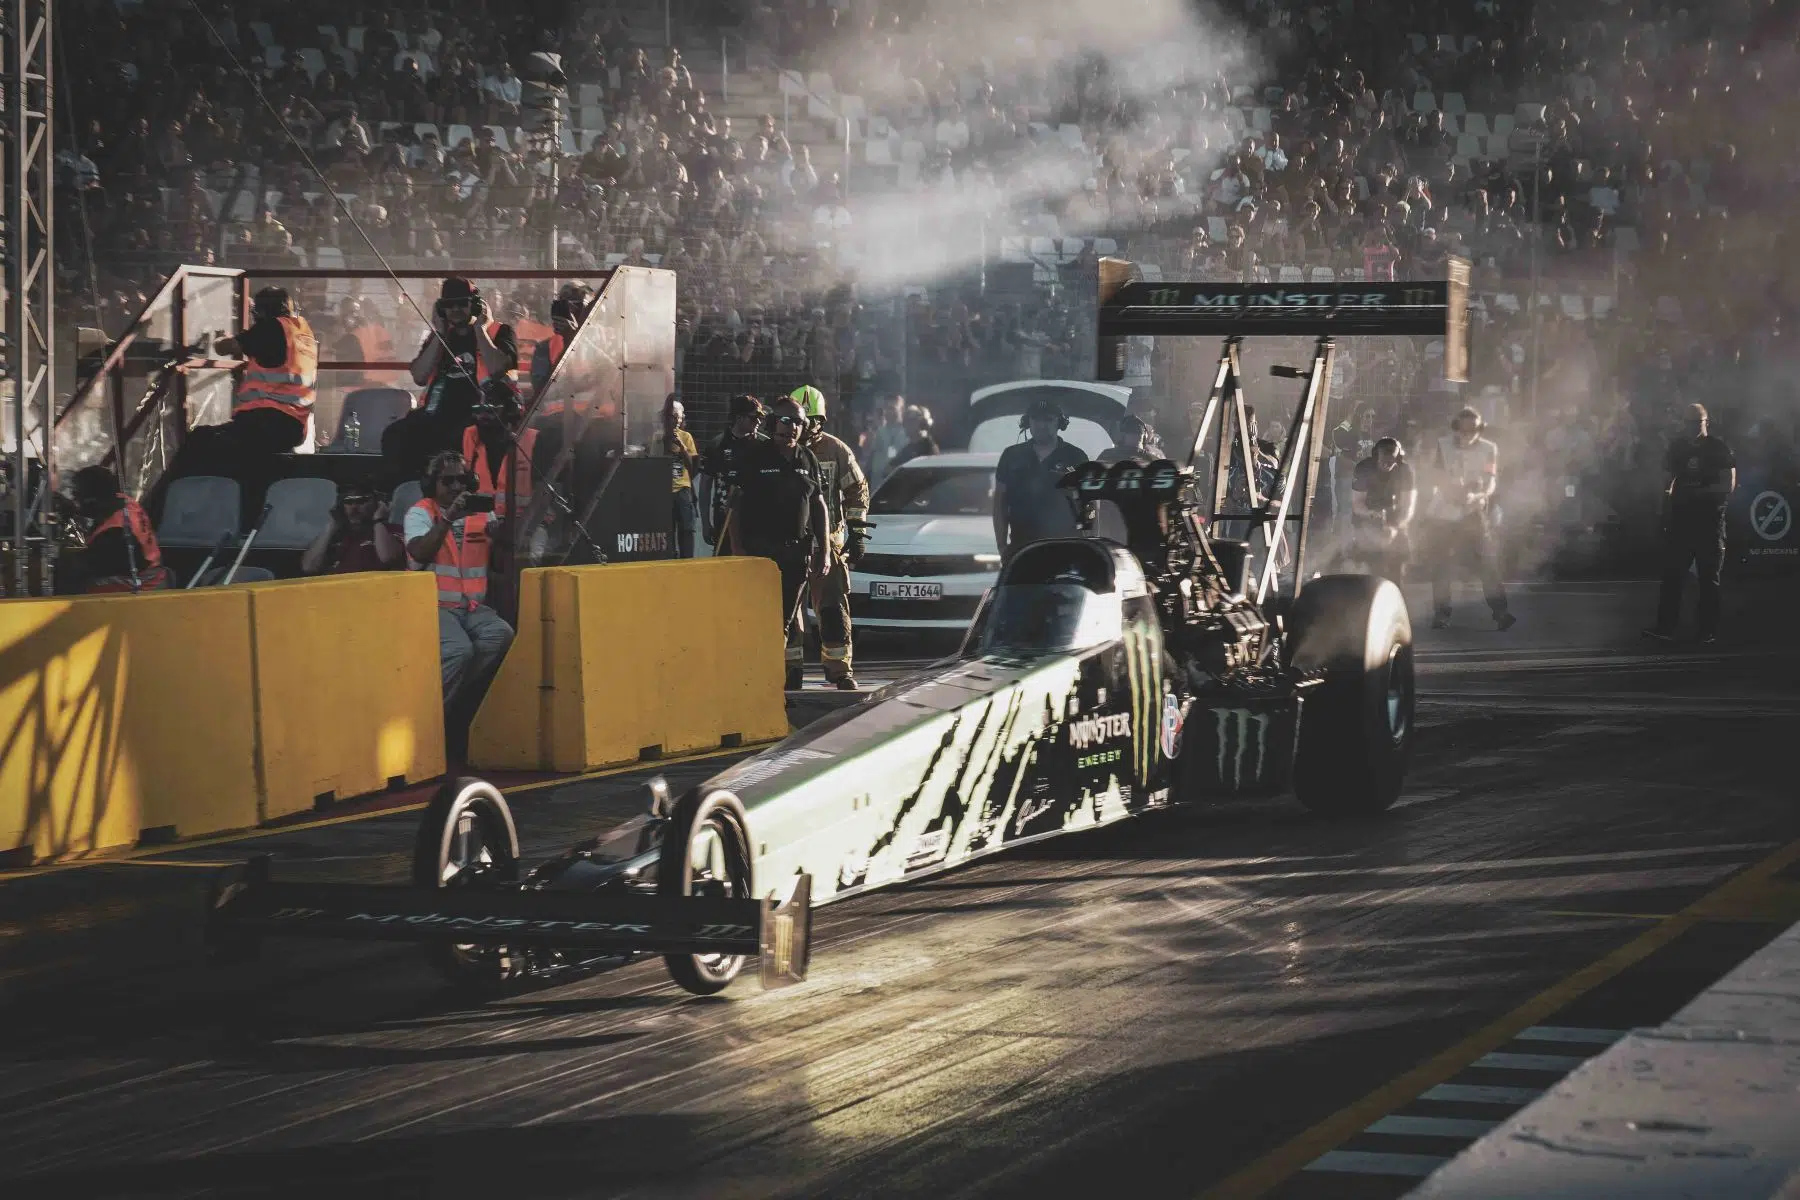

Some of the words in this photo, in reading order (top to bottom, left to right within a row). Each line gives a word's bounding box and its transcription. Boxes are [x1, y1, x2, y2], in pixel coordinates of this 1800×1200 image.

[877, 584, 891, 597] GL
[898, 584, 912, 598] FX
[914, 585, 940, 598] 1644
[1069, 712, 1131, 750] MONSTER
[1078, 750, 1121, 769] ENERGY
[346, 912, 652, 933] MONSTER
